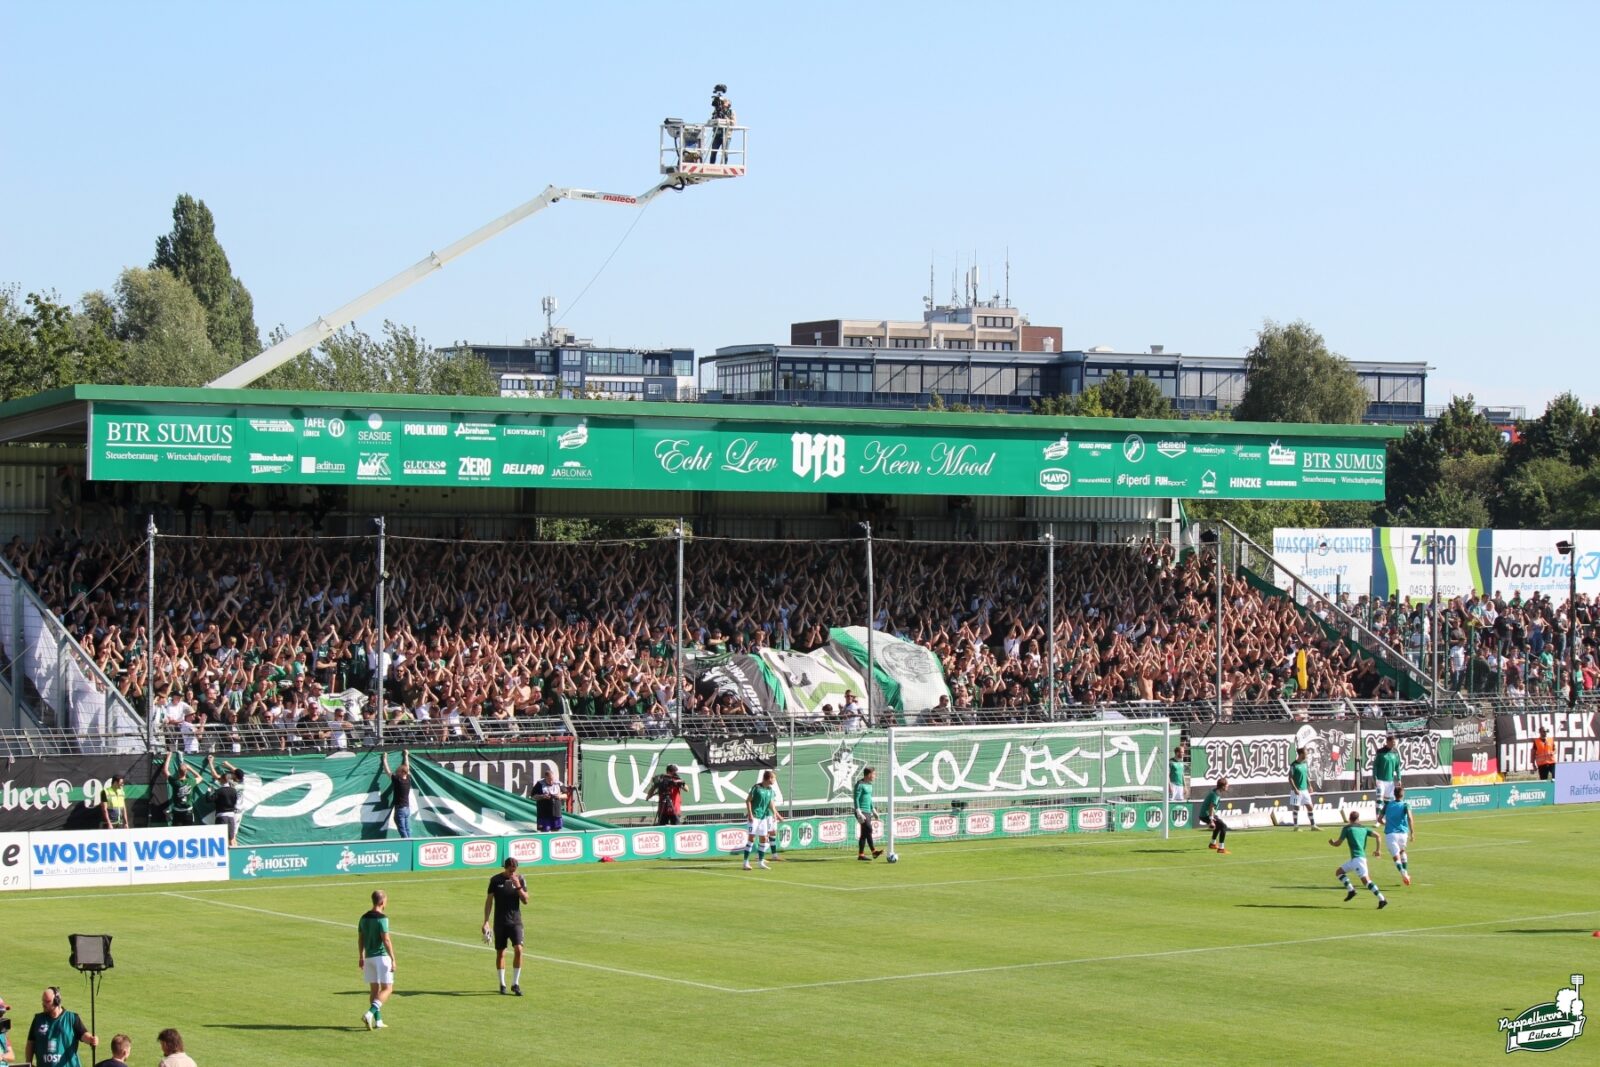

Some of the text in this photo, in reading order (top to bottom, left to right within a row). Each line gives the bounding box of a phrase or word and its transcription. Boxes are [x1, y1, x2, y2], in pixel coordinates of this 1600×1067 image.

[603, 194, 637, 204] mateco
[304, 417, 326, 429] TAFEL
[107, 421, 151, 442] BTR
[157, 423, 233, 444] SUMUS
[358, 431, 392, 441] SEASIDE
[106, 451, 232, 464] Steuerberatung Wirtschaftsprüfung
[654, 438, 713, 474] Echt
[790, 431, 846, 483] VfB
[859, 440, 996, 477] Keen Mood
[1303, 452, 1331, 469] BTR
[1335, 453, 1384, 470] SUMUS
[502, 463, 545, 475] DELLPRO
[551, 468, 593, 478] JABLONKA
[1042, 473, 1068, 483] MAYO
[1230, 477, 1262, 488] HINZKE
[1275, 536, 1372, 554] WASCH CENTER
[1494, 555, 1584, 578] NordBrief
[1461, 794, 1491, 804] HOLSTEN
[1520, 791, 1546, 801] HOLSTEN
[597, 837, 620, 845] MAYO
[680, 834, 702, 842] MAYO
[721, 832, 744, 840] MAYO
[133, 837, 226, 860] WOISIN
[424, 846, 448, 854] MAYO
[467, 844, 491, 852] MAYO
[514, 842, 537, 850] MAYO
[33, 842, 127, 865] WOISIN
[358, 852, 400, 864] HOLSTEN
[265, 857, 309, 869] HOLSTEN
